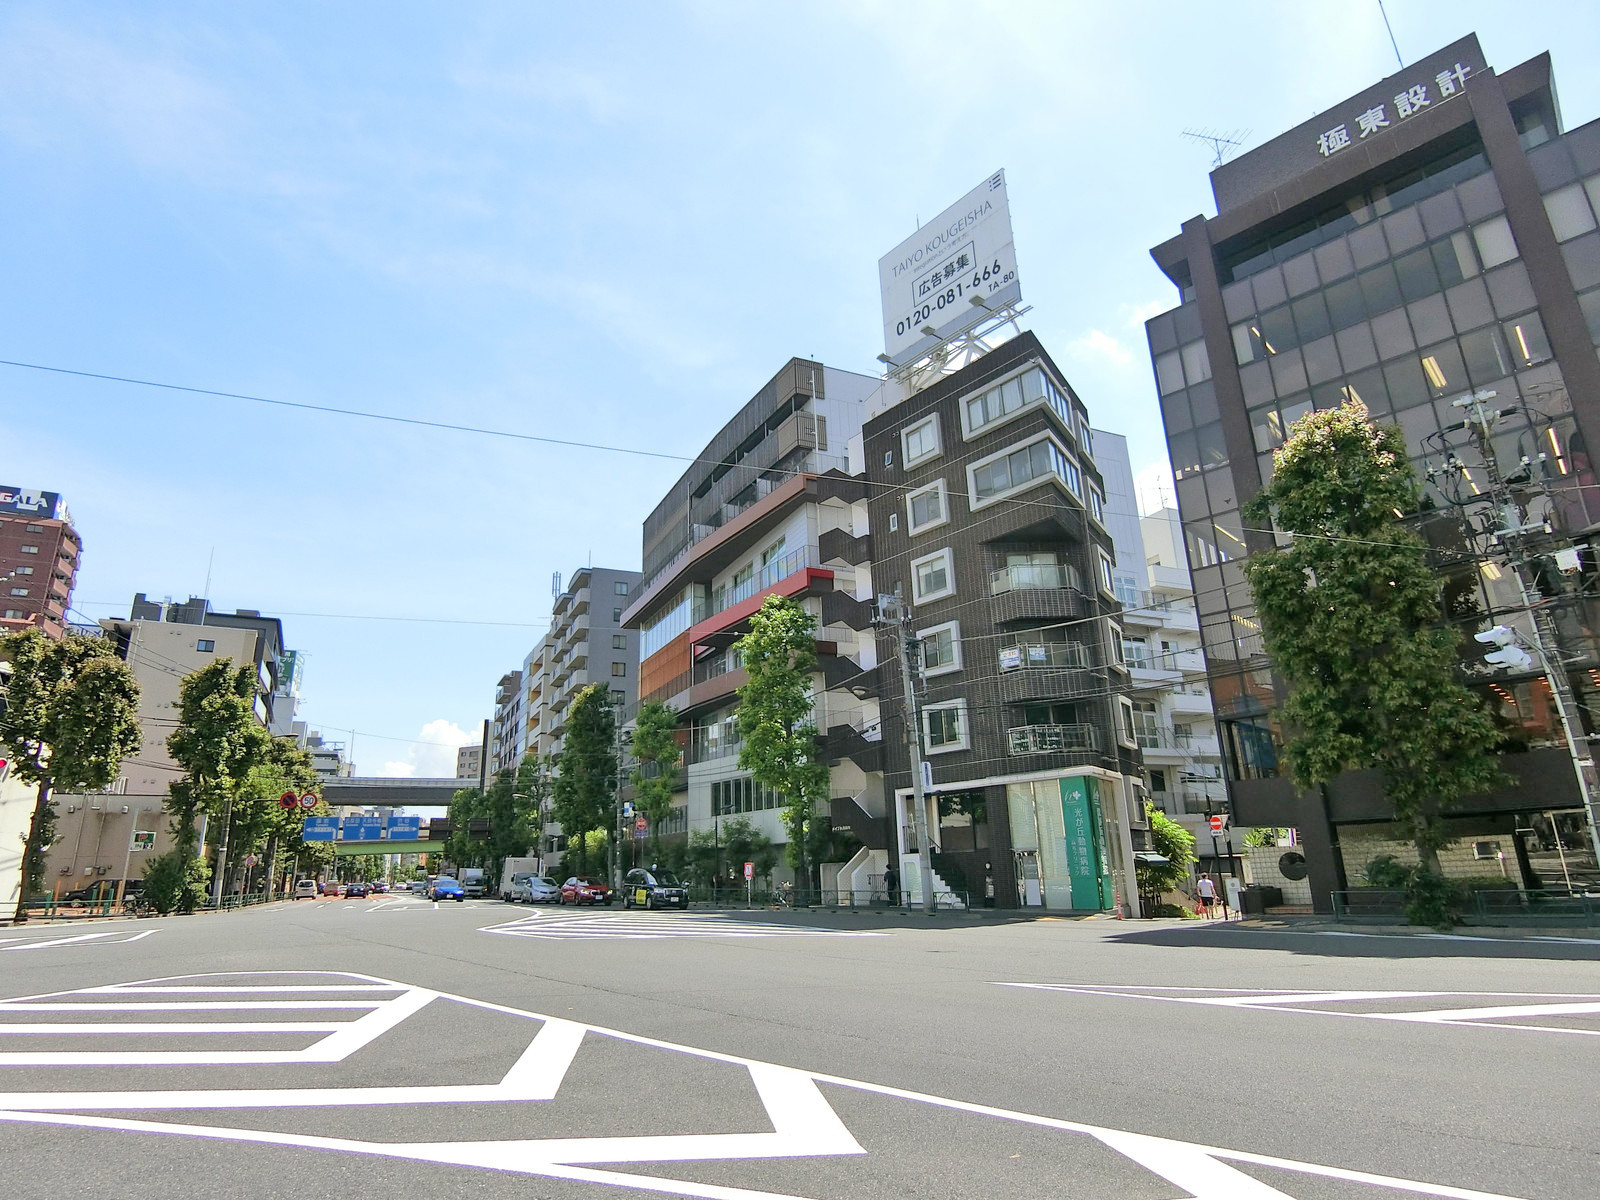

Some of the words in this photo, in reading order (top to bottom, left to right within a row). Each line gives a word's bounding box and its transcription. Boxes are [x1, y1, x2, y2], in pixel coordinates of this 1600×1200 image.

[1316, 62, 1471, 157] 極東設計
[892, 249, 923, 277] TAIYO
[925, 201, 992, 255] KOUGEISHA
[896, 259, 1001, 336] 0120-081-666
[918, 253, 970, 298] 広告募集
[988, 271, 1014, 292] TA-80
[304, 797, 315, 805] 50
